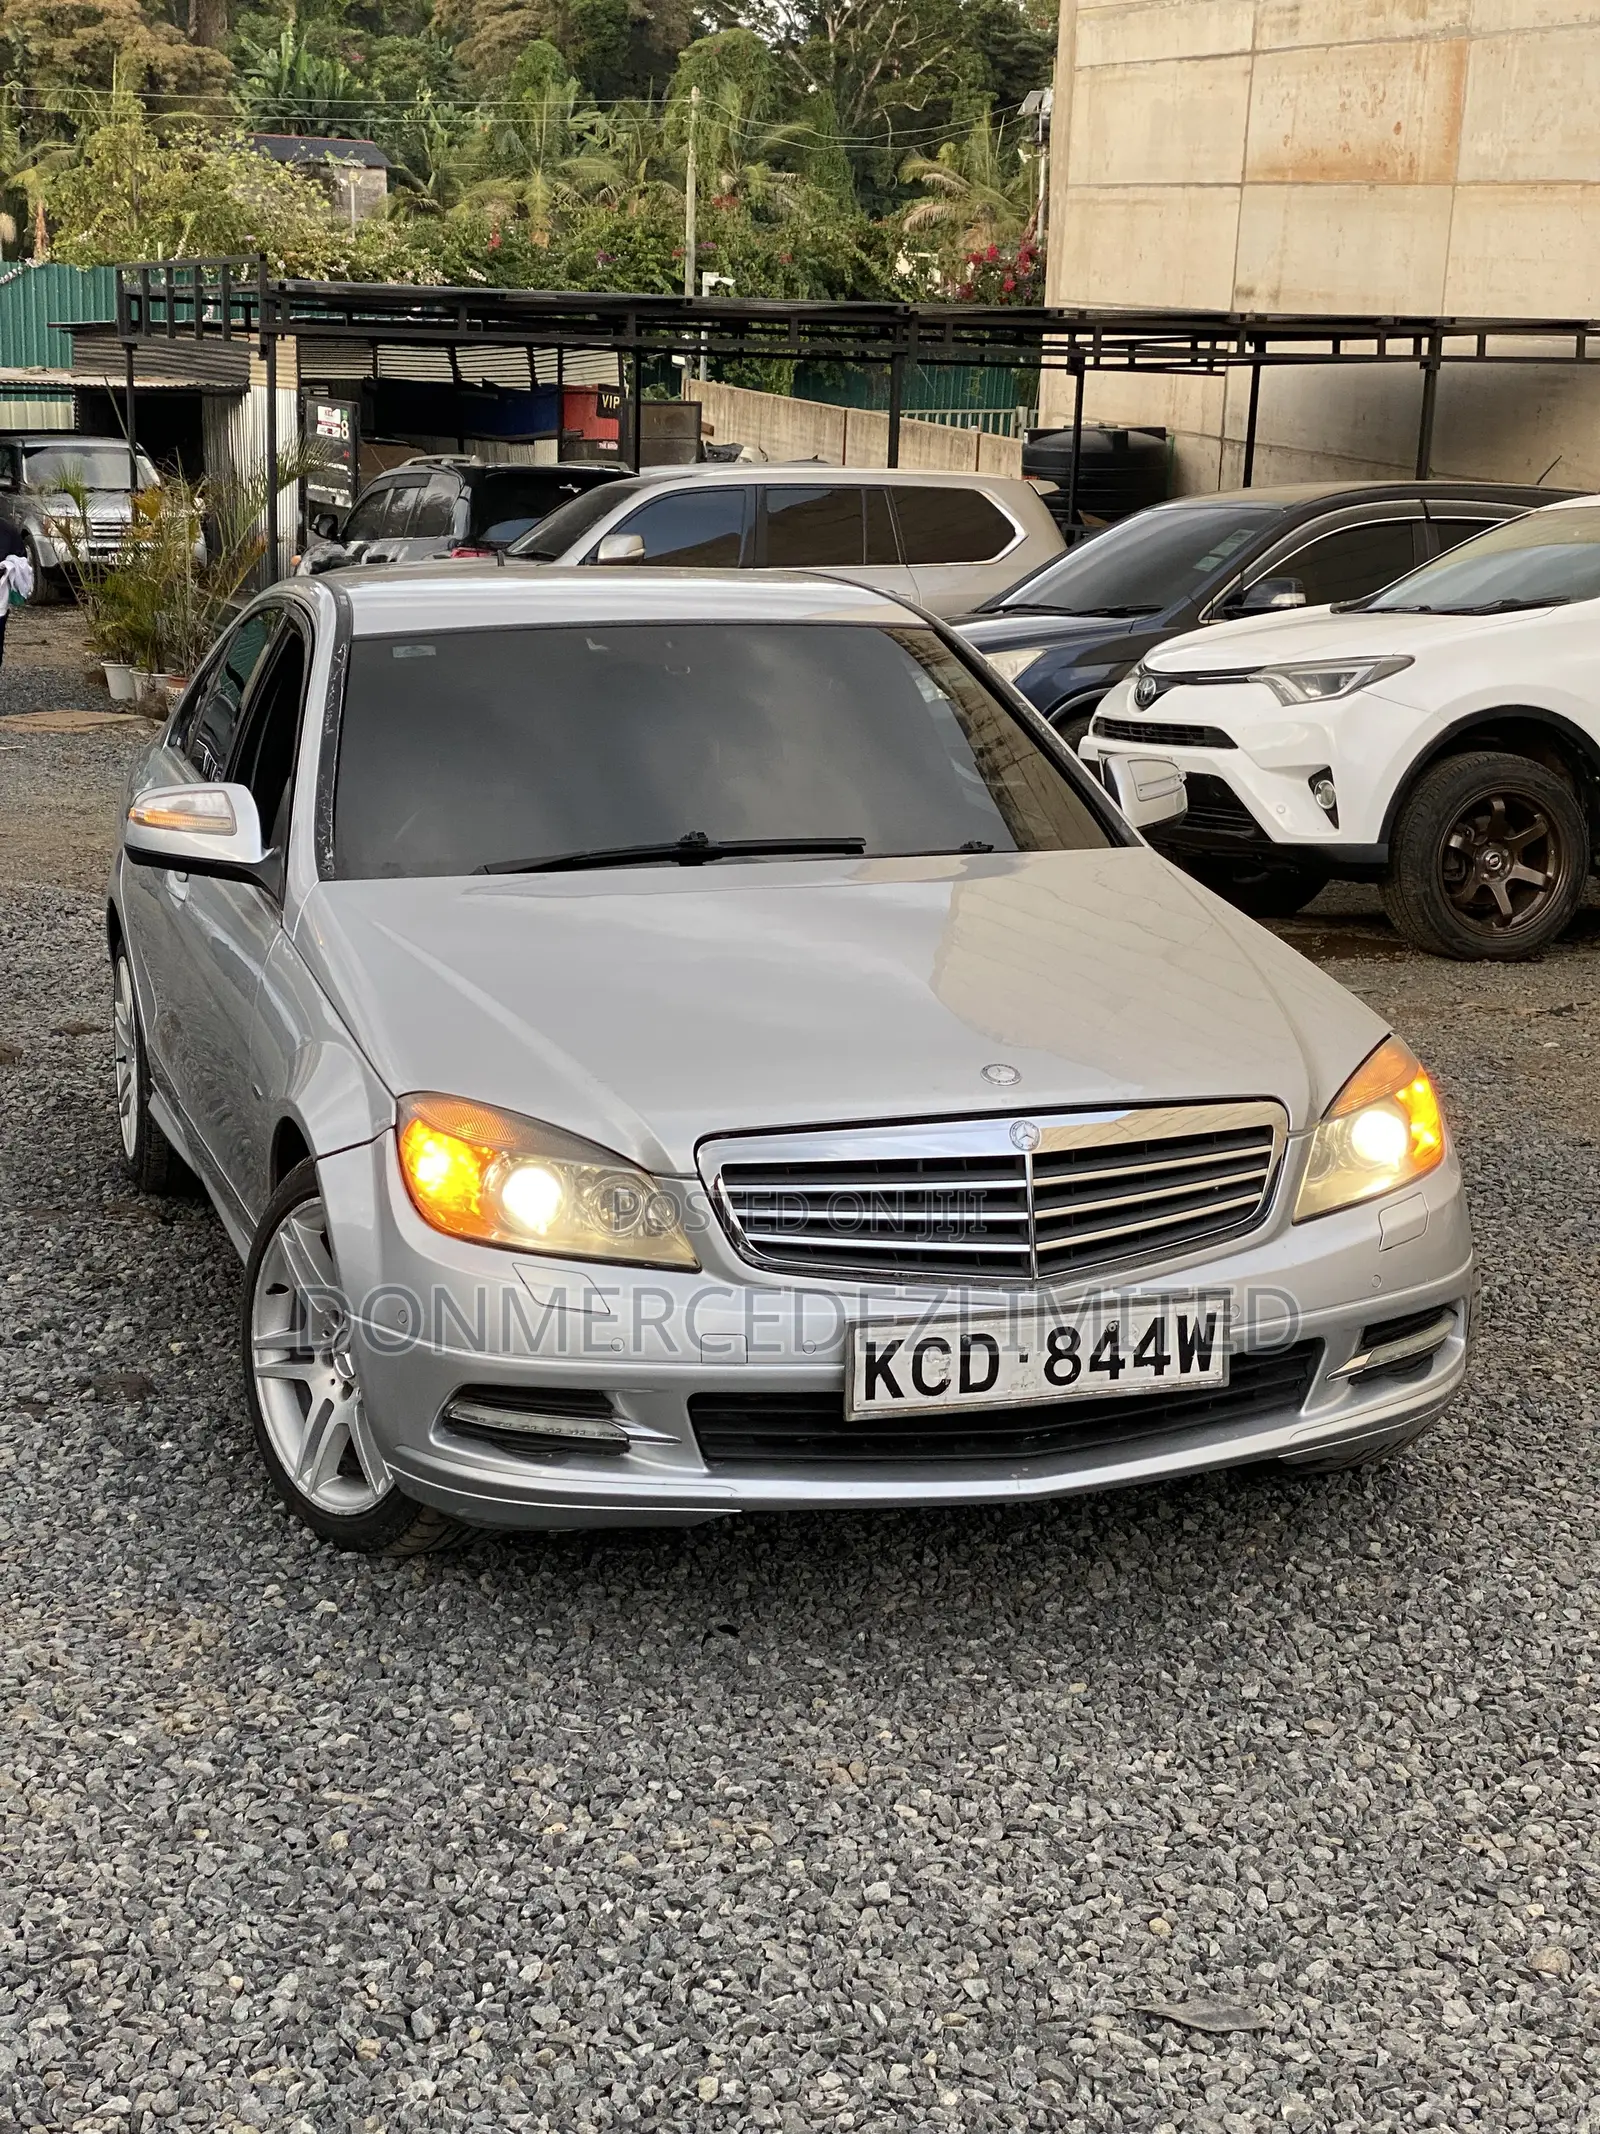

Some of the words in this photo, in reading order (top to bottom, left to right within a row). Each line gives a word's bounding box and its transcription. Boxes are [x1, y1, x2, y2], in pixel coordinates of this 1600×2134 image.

[602, 394, 620, 409] VIP
[864, 1332, 1000, 1400] KCD
[1043, 1311, 1218, 1387] 844W
